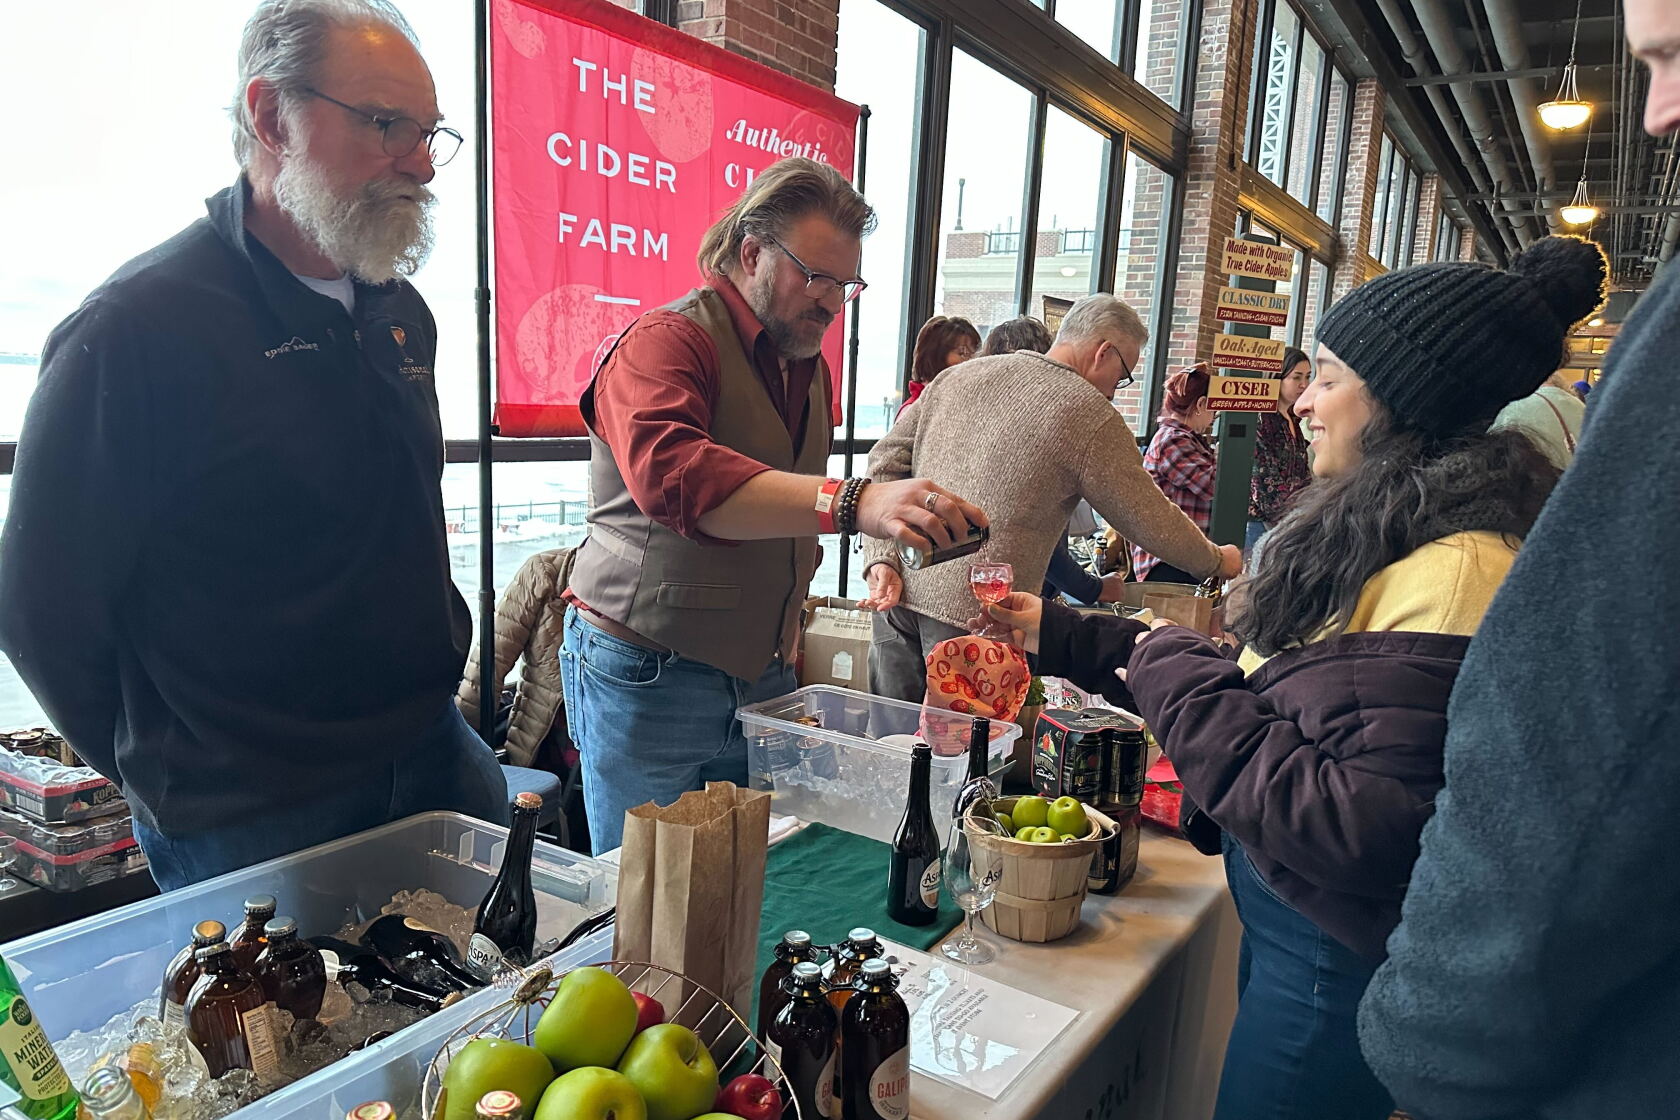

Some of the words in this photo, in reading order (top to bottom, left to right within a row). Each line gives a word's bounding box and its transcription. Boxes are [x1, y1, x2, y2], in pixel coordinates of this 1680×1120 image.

[572, 57, 656, 114] THE
[546, 132, 677, 193] CIDER
[558, 212, 669, 262] FARM
[1226, 240, 1248, 255] Made
[1249, 245, 1265, 258] with
[1265, 247, 1293, 264] Organic
[1226, 256, 1243, 270] True
[1244, 259, 1265, 273] Cider
[1265, 263, 1289, 278] Apples
[1222, 291, 1268, 308] CLASSIC
[1268, 296, 1289, 310] DRY
[1220, 338, 1246, 353] Oak
[1246, 342, 1280, 358] Aged
[1221, 380, 1270, 397] CYSER
[1210, 400, 1233, 408] GREEN
[14, 1032, 48, 1064] MINER
[877, 1077, 909, 1099] GALIP
